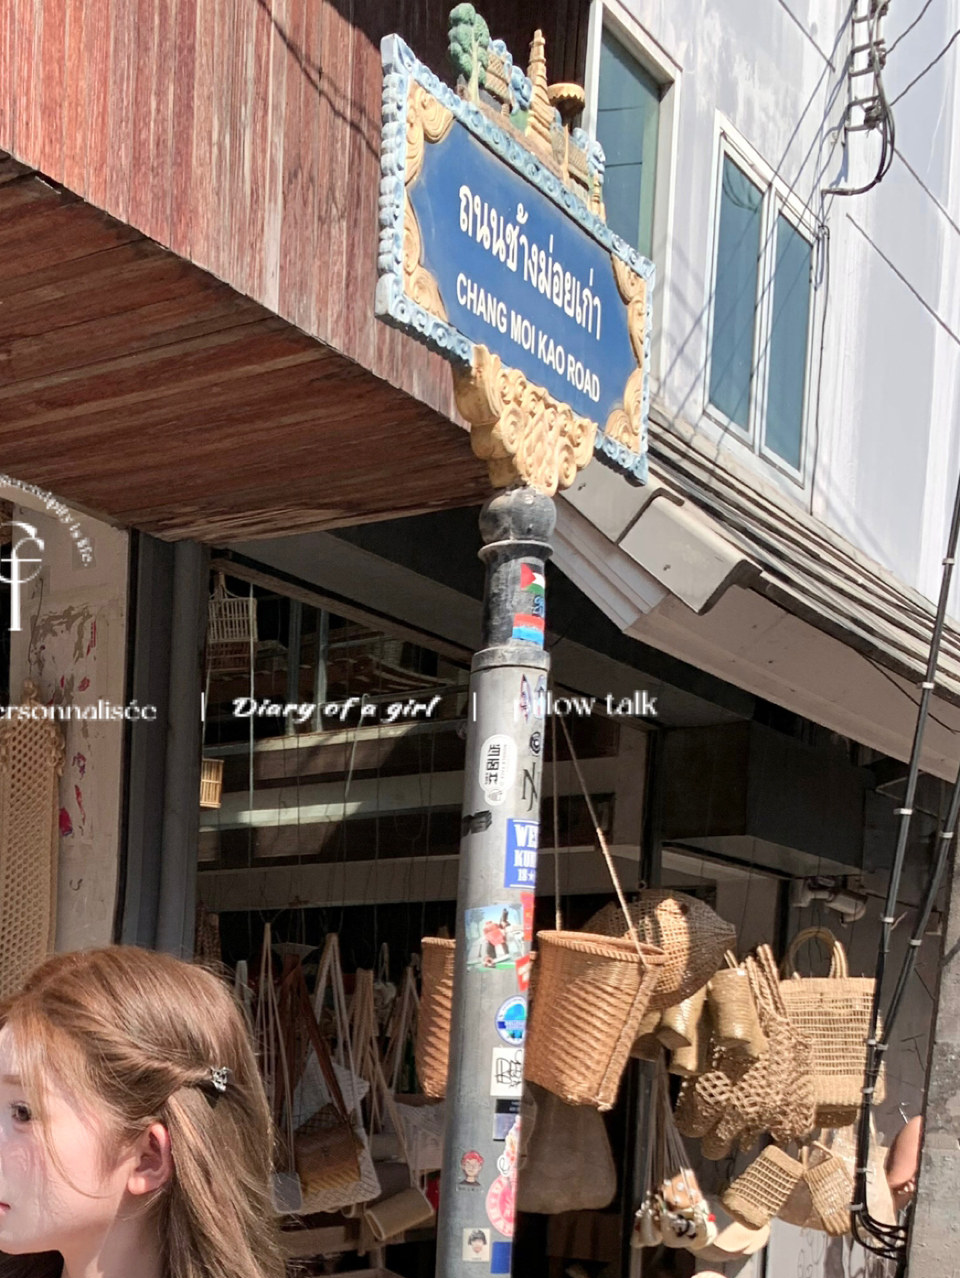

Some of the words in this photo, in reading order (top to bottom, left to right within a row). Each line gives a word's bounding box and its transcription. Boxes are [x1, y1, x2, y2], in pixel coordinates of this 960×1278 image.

[459, 185, 602, 341] ถนนช้างม่อยเก่า
[456, 272, 508, 334] CHANG
[510, 309, 536, 355] MOI
[537, 330, 566, 376] KAO
[567, 353, 601, 403] ROAD
